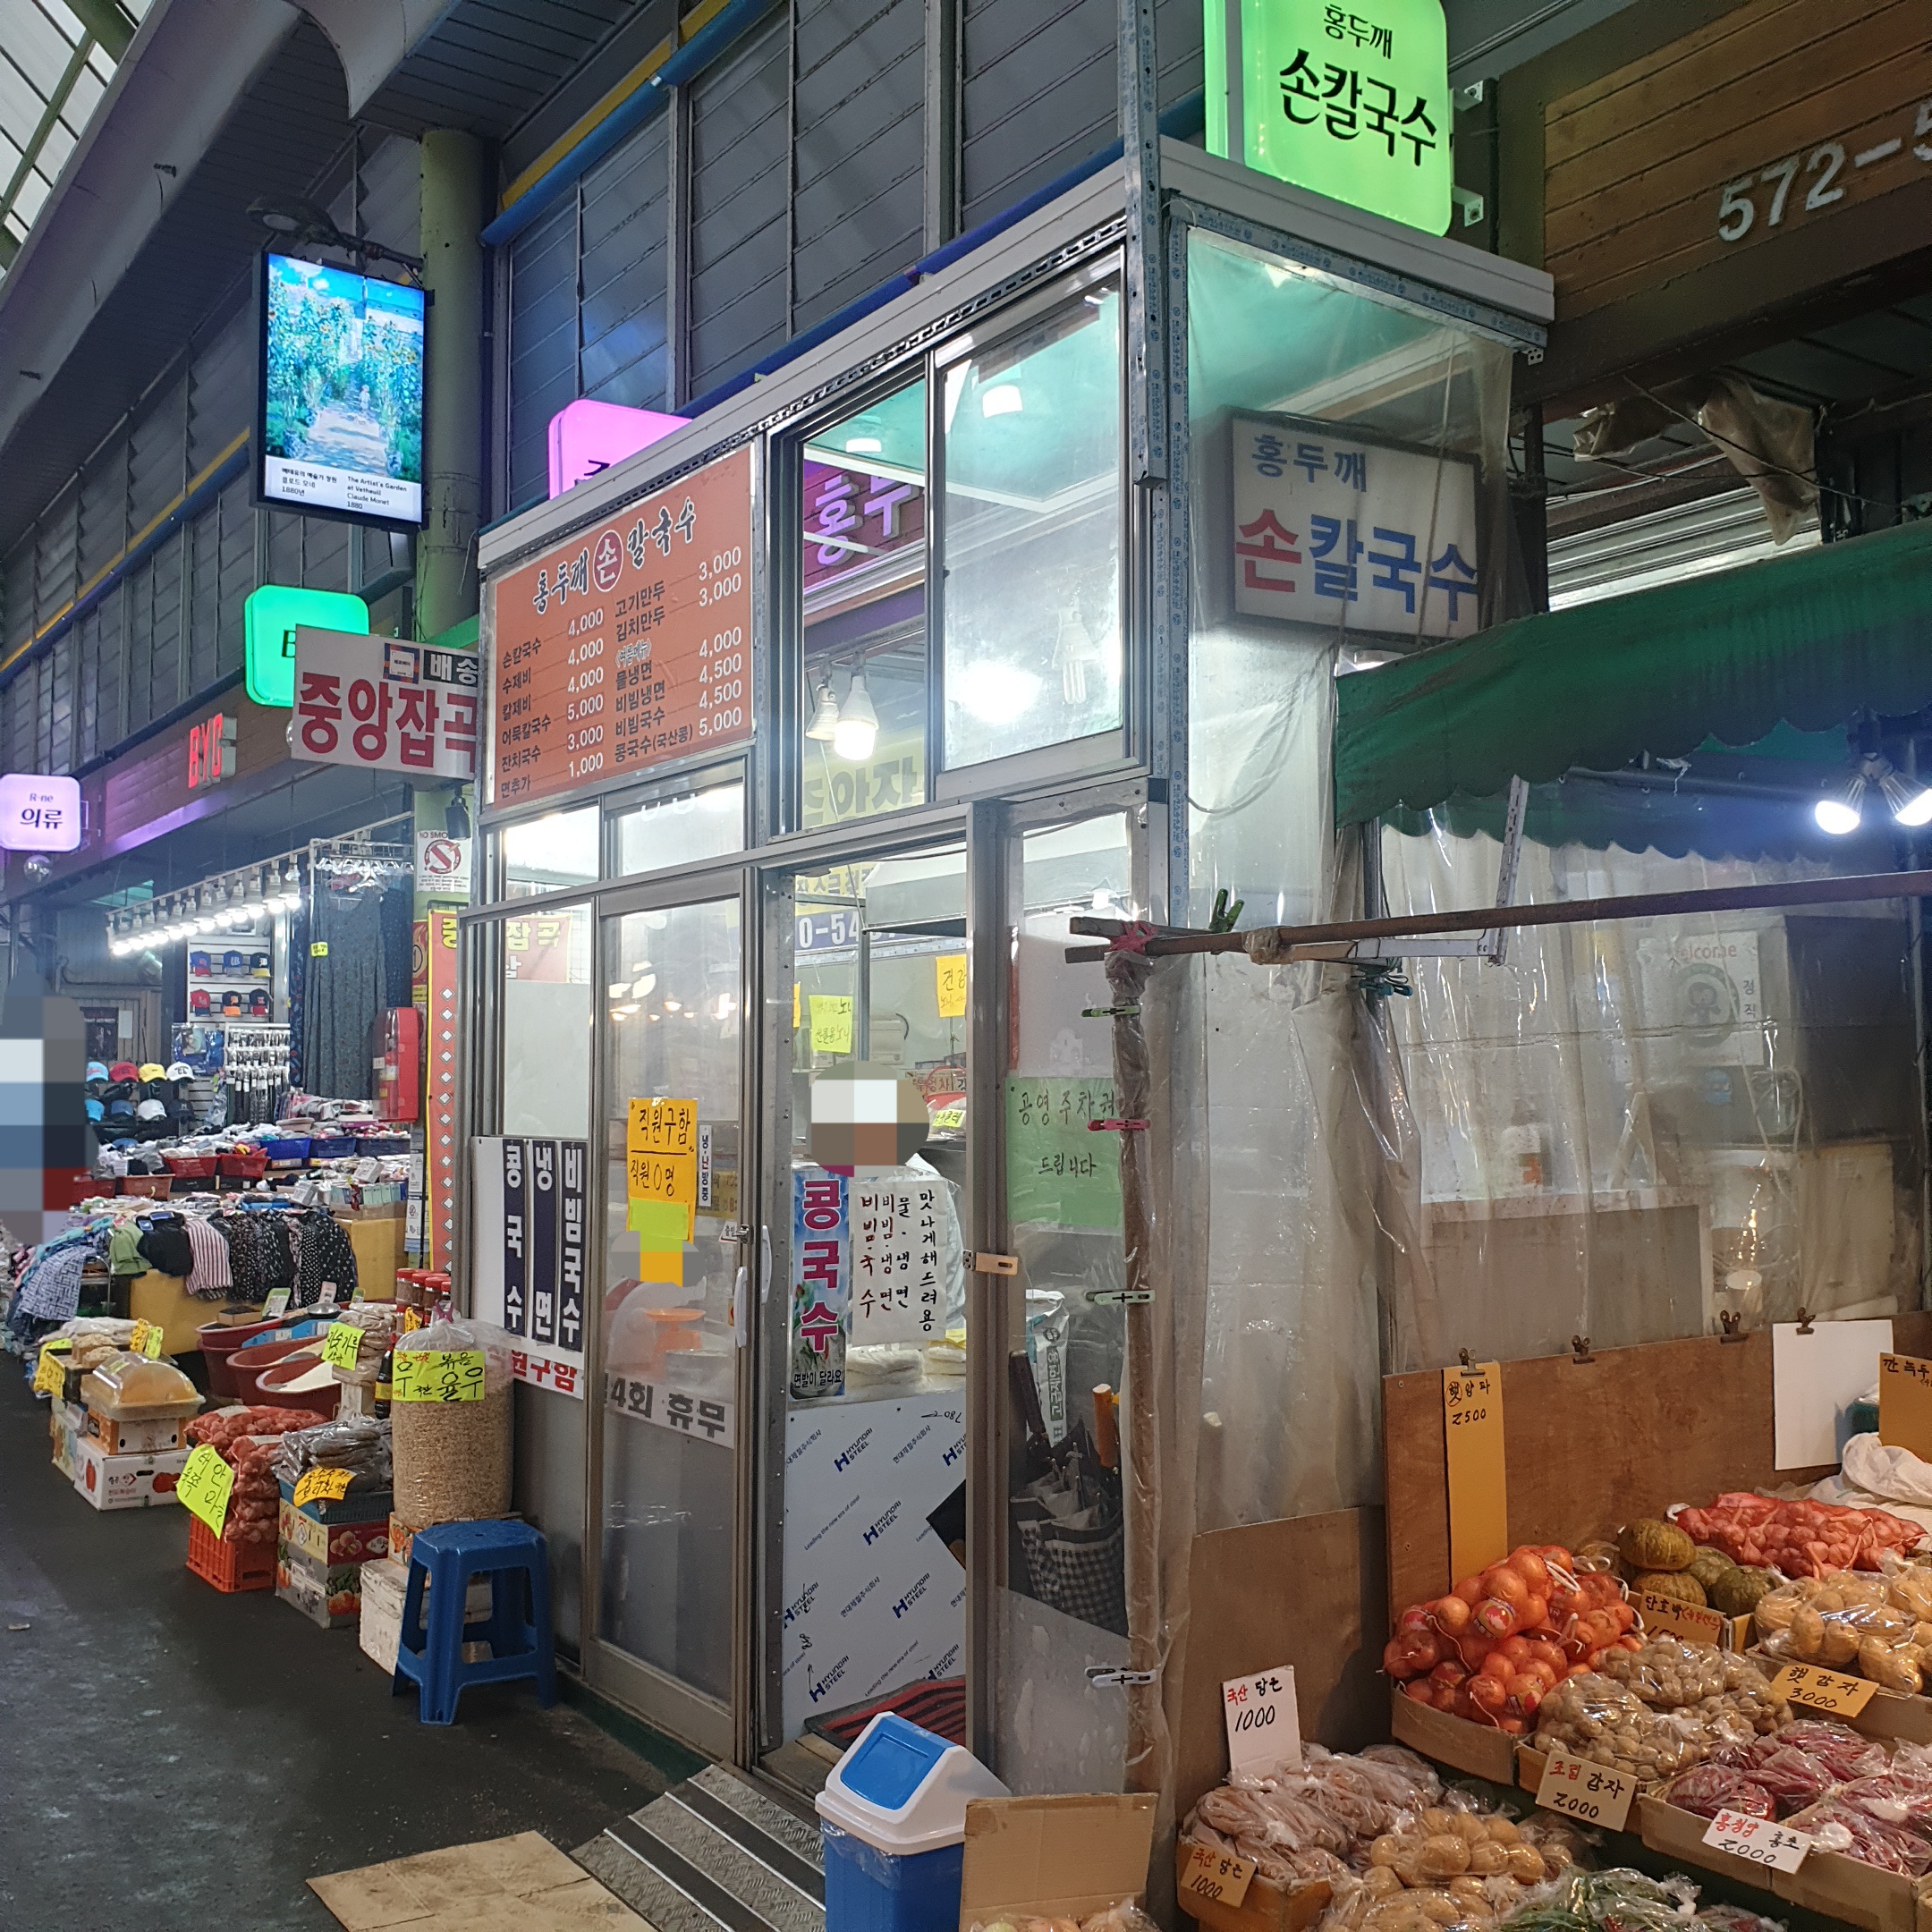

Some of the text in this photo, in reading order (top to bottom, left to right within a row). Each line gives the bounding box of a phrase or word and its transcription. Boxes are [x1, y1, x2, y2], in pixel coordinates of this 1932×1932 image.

[1323, 4, 1394, 60] 홍두깨
[1279, 48, 1438, 168] 손칼국수
[1252, 434, 1367, 493] 홍두깨
[347, 476, 359, 484] The
[386, 483, 408, 492] Garden
[347, 493, 390, 505] Claude Monet
[533, 547, 590, 615] 홍두깨
[1235, 507, 1478, 623] 손칼국수
[614, 546, 741, 618] 고기만두 3,000
[616, 572, 741, 643] 김치만두 3,000
[502, 607, 604, 669] 손칼국수 4,000
[430, 653, 479, 685] 배송
[502, 638, 604, 694] 수제비 4,000
[615, 626, 742, 691] 물냉면 4,000
[502, 666, 604, 722] 칼제비 4,000
[615, 653, 742, 713] 비빔냉면 4,500
[298, 672, 477, 773] 중앙잡곡
[502, 694, 604, 745] 어묵칼국수 5,000
[615, 679, 742, 737] 비빔국수 4,500
[699, 707, 742, 736] 5,000
[188, 713, 224, 790] BYC
[501, 724, 604, 773] 잔치국수 3,000
[501, 752, 604, 799] 면추가 1,000
[20, 807, 64, 831] 의류
[419, 831, 428, 839] NO
[1019, 1089, 1050, 1126] 공영
[639, 1106, 691, 1146] 직원구함
[631, 1158, 650, 1190] 직원
[1038, 1152, 1097, 1178] 드립니다
[504, 1145, 524, 1333] 콩국수
[535, 1146, 552, 1339] 냉면
[563, 1146, 583, 1343] 비빔국수
[802, 1180, 841, 1353] 콩국수
[793, 1368, 843, 1389] 면발이 달라요
[605, 1373, 725, 1438] 4회 휴무
[1452, 1408, 1487, 1425] 2500
[786, 1429, 822, 1465] 대제철주식회사
[845, 1428, 873, 1455] HYUNDAI
[849, 1441, 869, 1461] STEEL
[874, 1500, 902, 1529] HYUNDAI
[877, 1513, 899, 1534] STEEL
[791, 1581, 819, 1610] HYUNDAI
[903, 1572, 931, 1602] HYUNDAI
[907, 1586, 928, 1607] STEEL
[821, 1655, 850, 1684] HYUNDAI
[933, 1644, 960, 1672] HYUNDAI
[936, 1657, 957, 1678] STEEL
[825, 1668, 846, 1690] STEEL
[1227, 1676, 1283, 1707] 국산 당근
[1789, 1688, 1837, 1708] 3000
[1235, 1705, 1275, 1733] 1000
[1548, 1760, 1625, 1800] 조림 감자
[1553, 1792, 1599, 1818] 2000
[1192, 1848, 1243, 1879] 국산 당근
[1718, 1838, 1777, 1863] 2000
[1191, 1874, 1224, 1898] 1000
